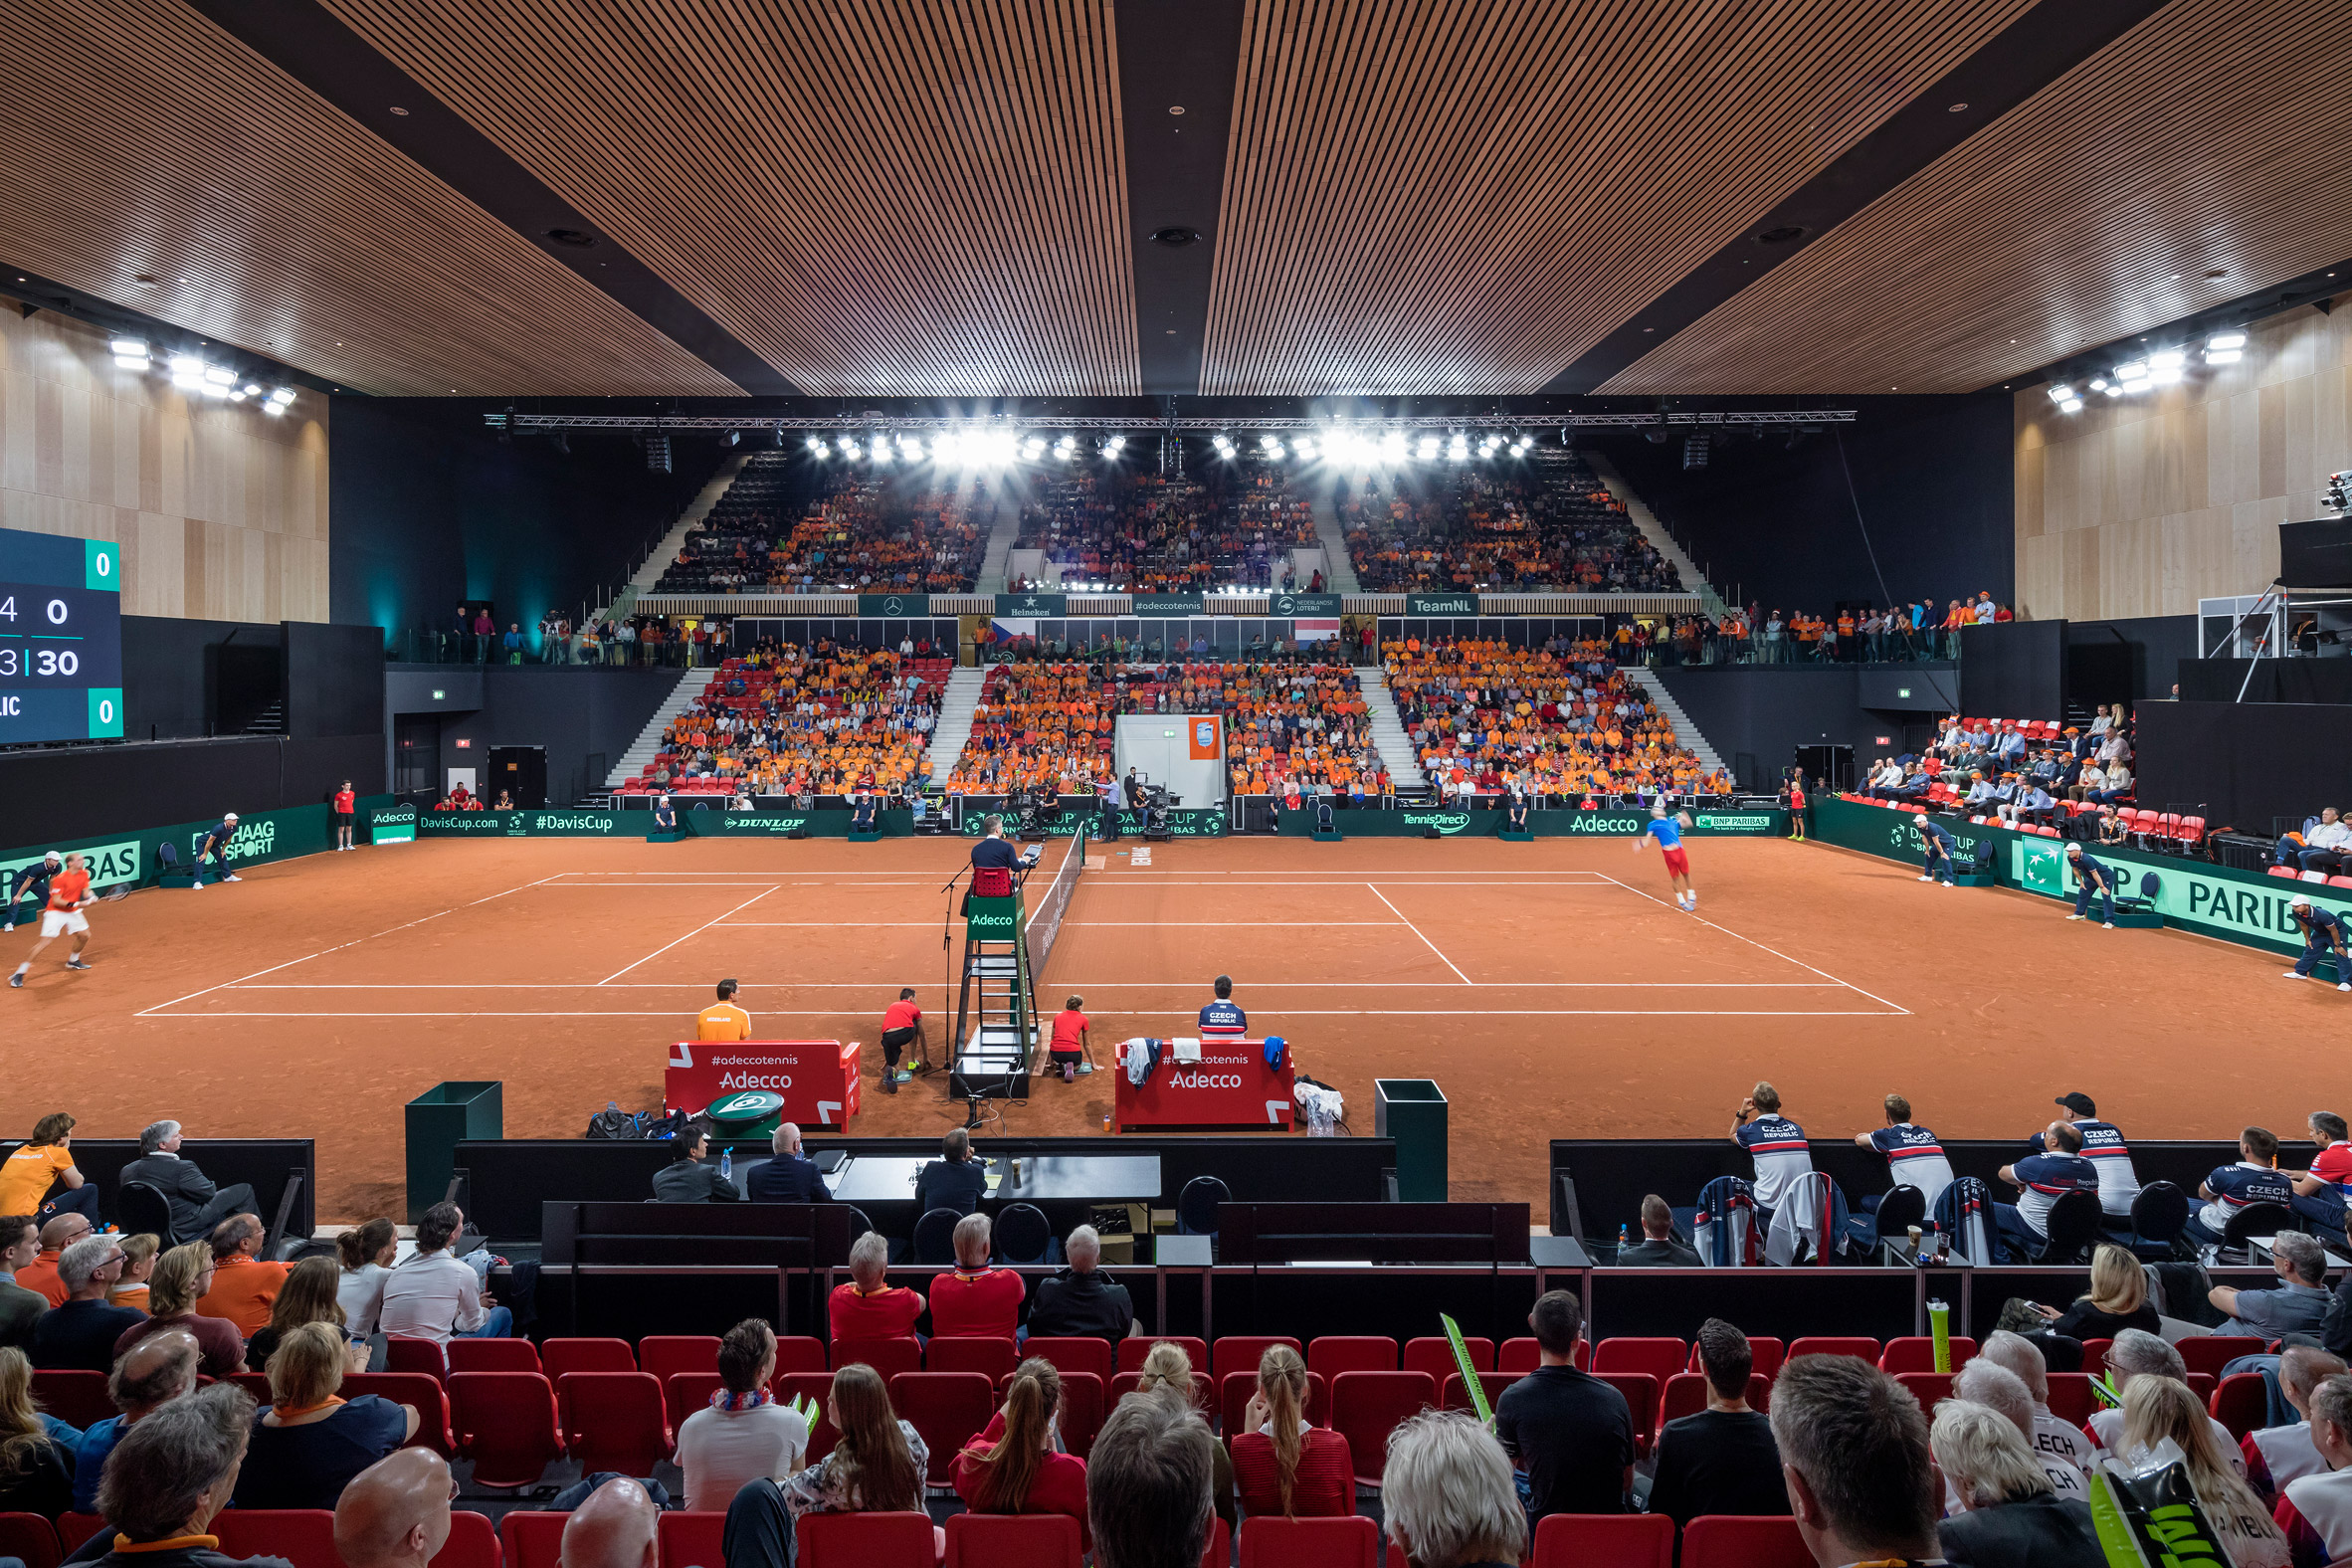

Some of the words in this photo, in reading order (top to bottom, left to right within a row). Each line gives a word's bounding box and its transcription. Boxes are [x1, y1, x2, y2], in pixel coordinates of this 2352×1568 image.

[96, 552, 110, 577] 0
[0, 596, 18, 622] 4
[47, 599, 68, 625] 0
[1135, 600, 1201, 610] #adeccotennis
[1415, 600, 1471, 612] TeamNL
[1011, 608, 1050, 617] Heineken
[37, 650, 79, 677] 30
[98, 699, 113, 724] 0
[372, 812, 415, 824] Adecco
[421, 817, 498, 831] DavisCup.com
[536, 815, 613, 833] #DavisCup
[1404, 814, 1466, 825] TennisDirect
[1570, 815, 1639, 832] Adecco
[971, 914, 1013, 925] Adecco
[711, 1055, 798, 1066] #adeccotennis
[719, 1071, 792, 1088] Adecco
[1169, 1071, 1242, 1088] Adecco
[1761, 1123, 1797, 1132] CZECH
[2083, 1129, 2118, 1139] CZECH
[2246, 1184, 2289, 1196] CZECH
